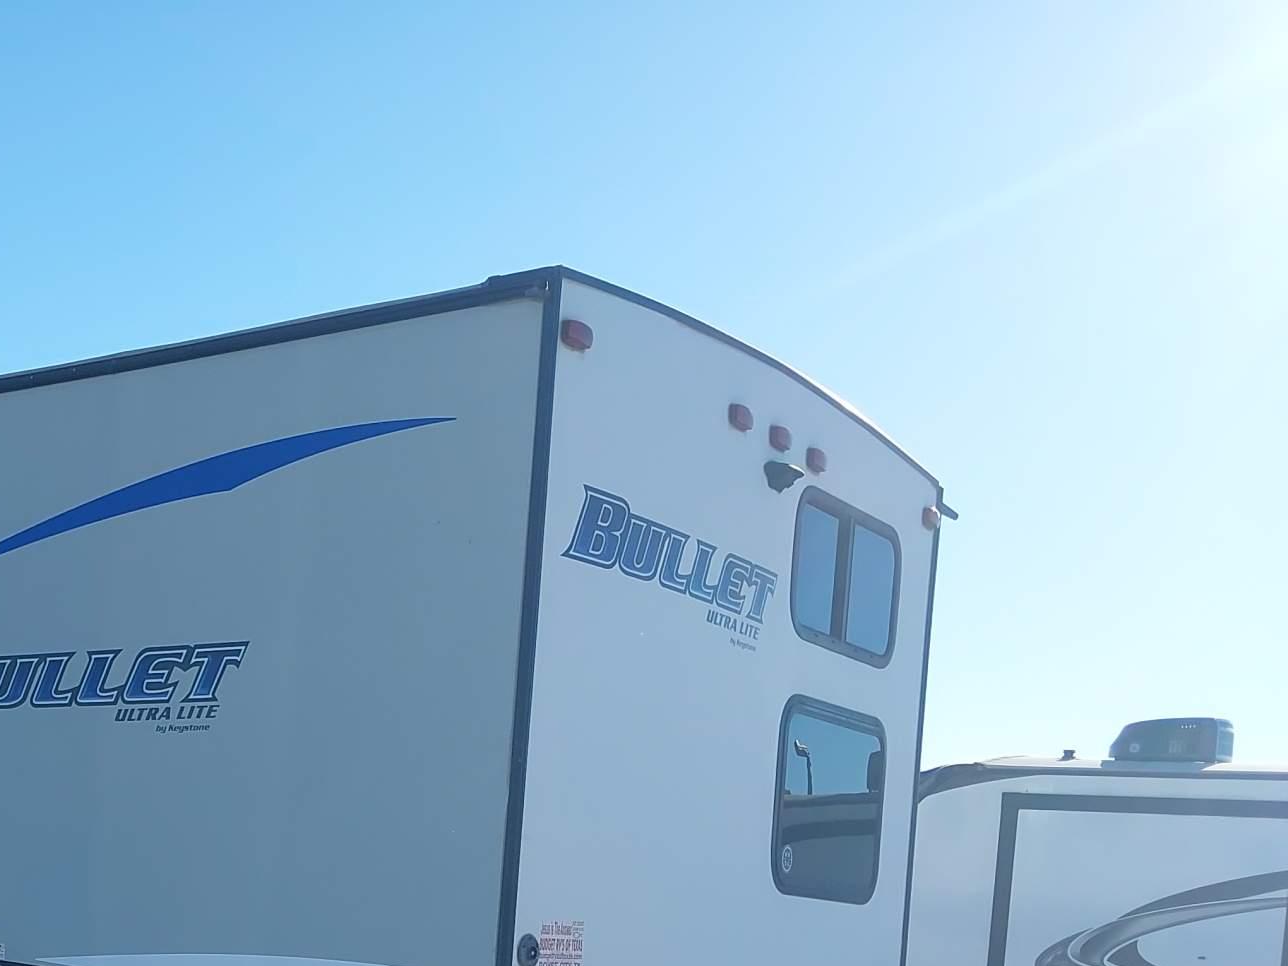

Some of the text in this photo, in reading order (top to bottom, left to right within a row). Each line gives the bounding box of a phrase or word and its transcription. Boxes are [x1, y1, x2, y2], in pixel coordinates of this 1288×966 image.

[561, 484, 778, 624] BULLET
[706, 609, 760, 641] ULTRA LITE
[115, 704, 220, 721] ULTRA LITE
[156, 725, 167, 733] by
